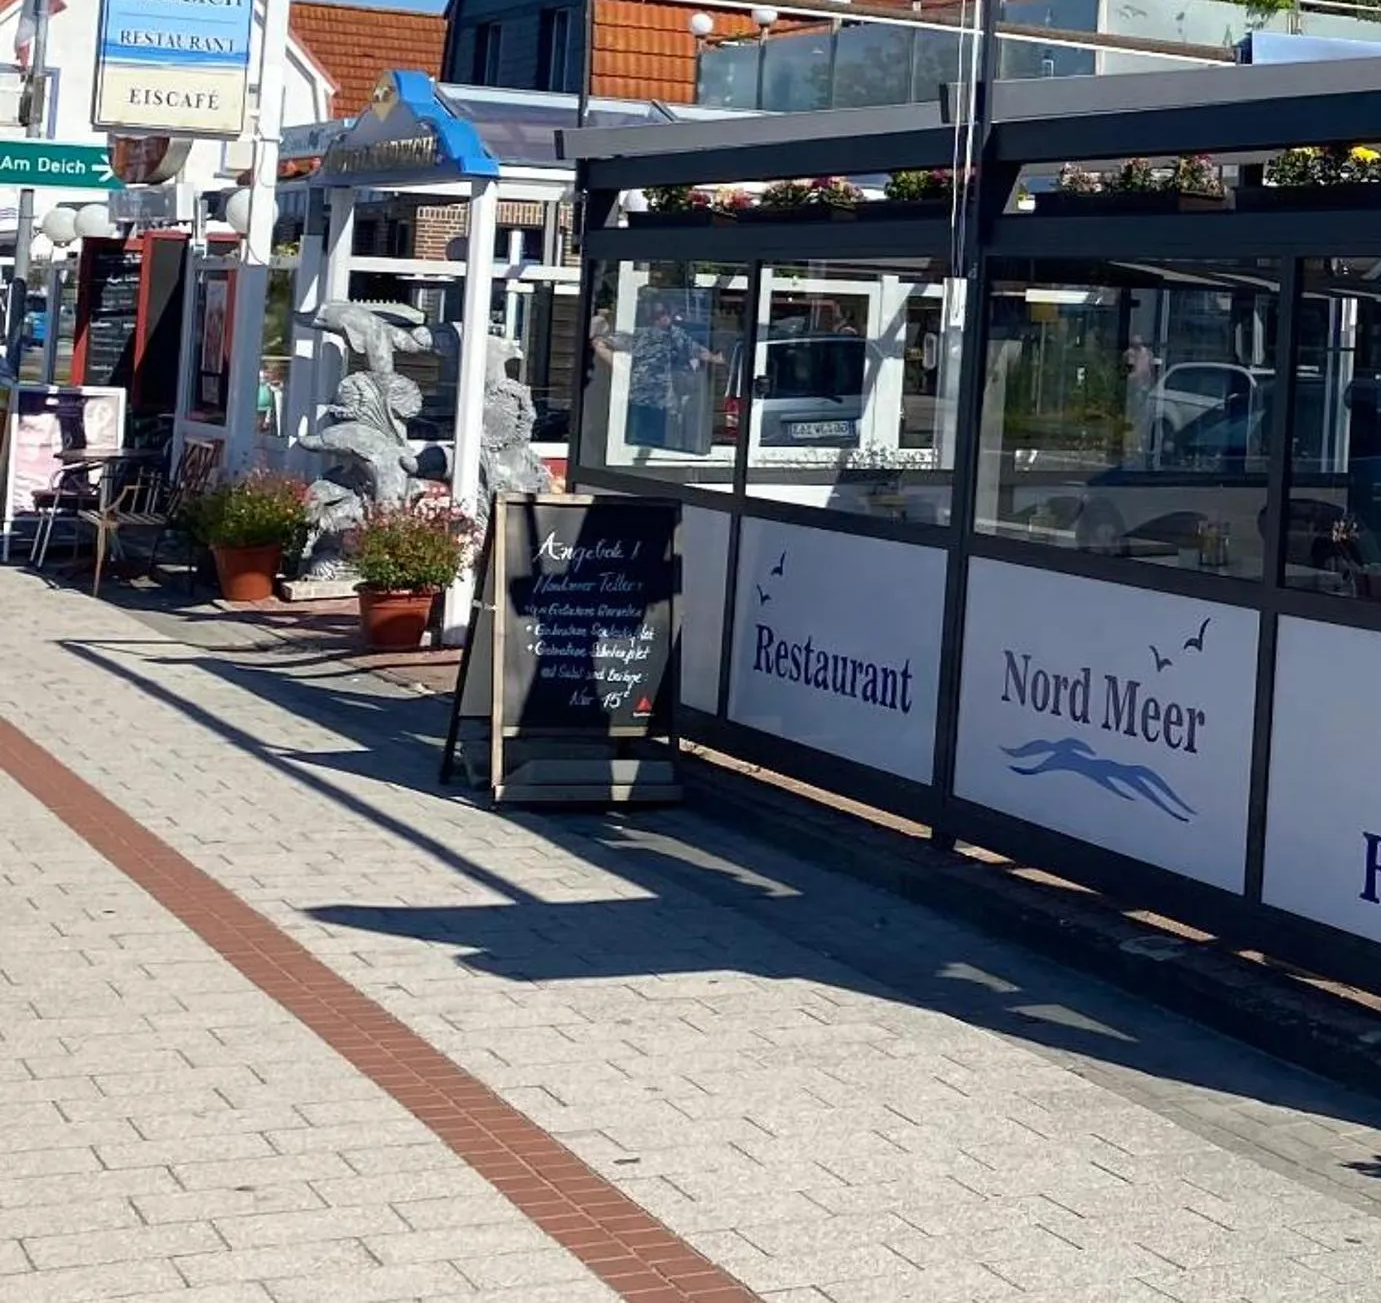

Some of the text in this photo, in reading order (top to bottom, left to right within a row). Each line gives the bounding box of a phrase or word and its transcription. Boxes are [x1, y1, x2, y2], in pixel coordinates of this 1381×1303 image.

[120, 30, 236, 53] RESTAURANT
[129, 88, 220, 110] EISCAFÉ
[0, 155, 86, 174] Am Deich
[753, 624, 913, 715] Restaurant
[1001, 649, 1206, 755] Nord Meer
